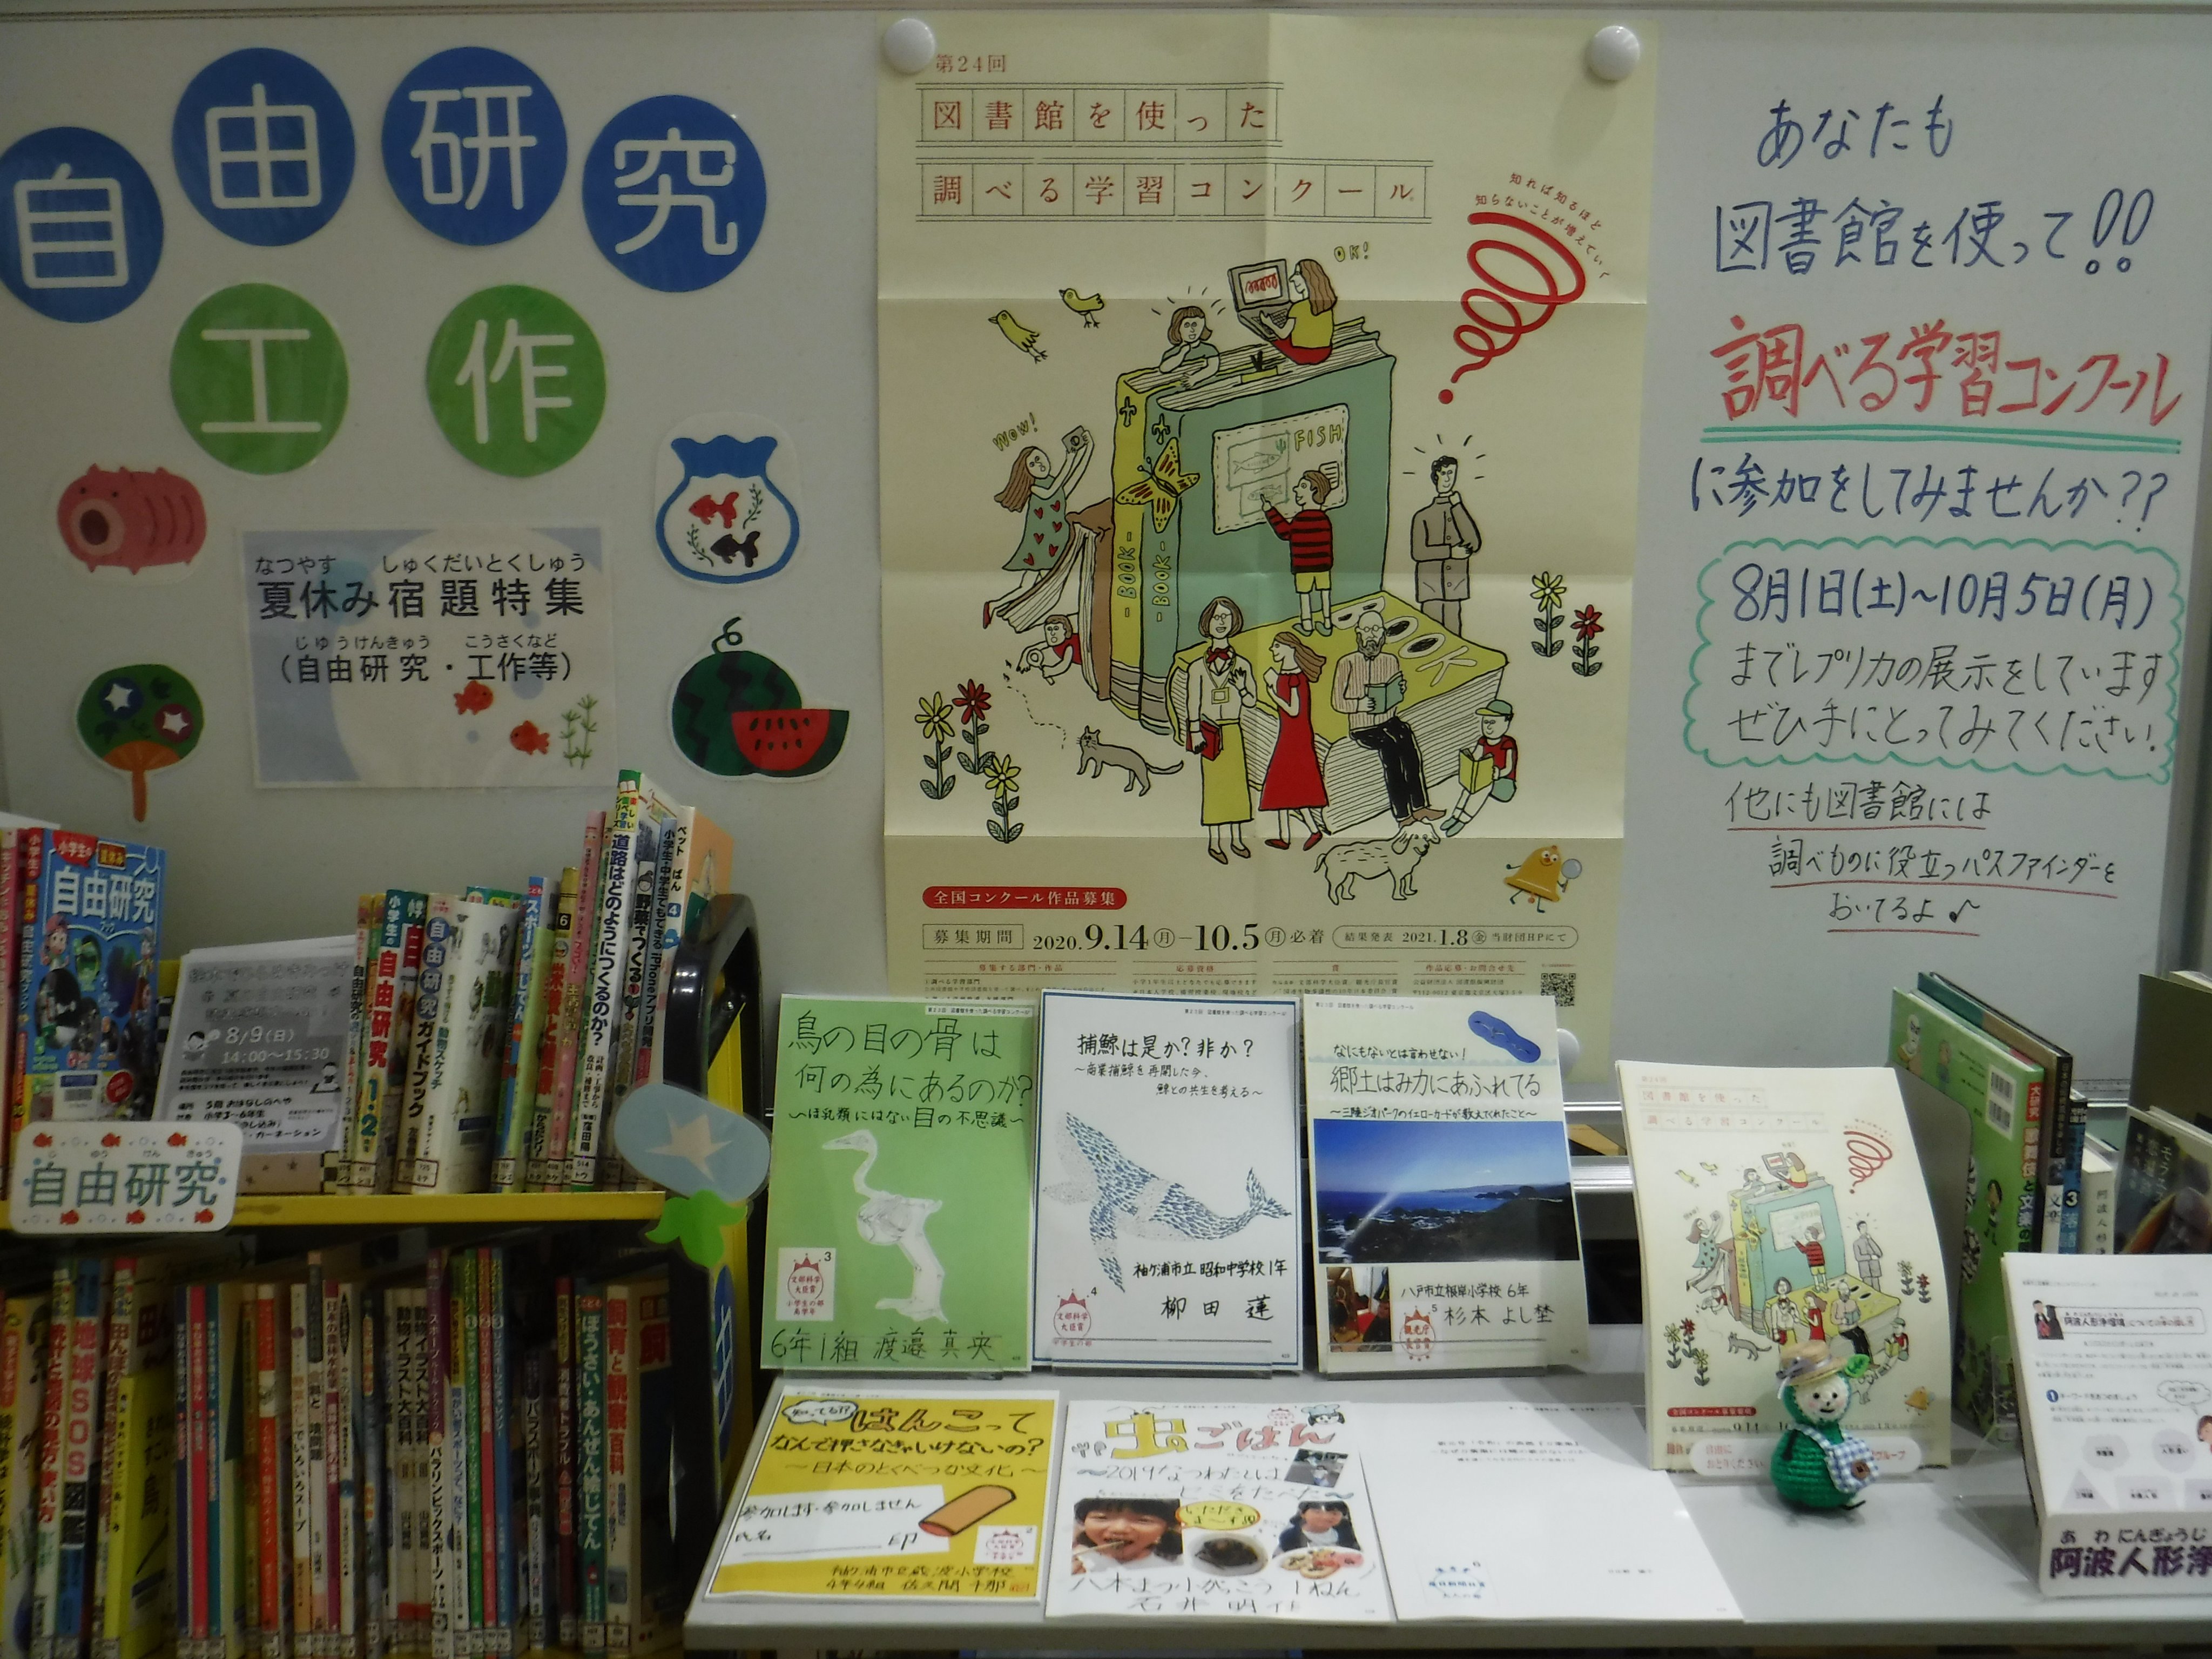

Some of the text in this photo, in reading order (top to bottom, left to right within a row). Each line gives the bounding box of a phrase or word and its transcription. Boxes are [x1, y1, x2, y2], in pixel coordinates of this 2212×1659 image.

[935, 55, 1007, 73] 第24回
[933, 100, 1267, 132] 図書館を使った
[1757, 94, 1952, 168] あなたも
[933, 176, 1411, 205] 調べる学習コンクール
[1509, 173, 1602, 230] 知れば知るほど
[1475, 194, 1609, 279] 知らないことが増えていく
[1334, 241, 1370, 262] OK!
[200, 318, 575, 444] 工作
[1710, 315, 2183, 426] 調べる学習コンクール
[993, 412, 1038, 451] WOW!
[1295, 424, 1344, 453] FISH
[255, 553, 585, 575] なつやす しゅくだいとくしゅう
[257, 577, 584, 620] 夏休み宿題特集
[295, 633, 557, 650] じゆうけんきゅう こうさくなど
[1730, 642, 2163, 705] までレプリカの展示をしています
[1724, 780, 1991, 825] 他にも図書館には
[1769, 834, 2115, 886] 調べものに役立つパスファインダーを
[52, 865, 156, 924] 自由研究
[933, 890, 1116, 906] 全国コンクール作品募集
[1829, 892, 1935, 923] おいてるよ
[934, 929, 1013, 945] 募集期間
[1345, 932, 1394, 942] 結果発表
[368, 950, 398, 1067] 自由研究
[788, 1009, 1002, 1062] 鳥の目の骨は
[1330, 1065, 1541, 1100] 郷土はみ力にあふれてる
[28, 1161, 220, 1209] 自由研究
[2066, 1191, 2078, 1206] 3
[824, 1251, 832, 1262] 3
[791, 1276, 821, 1284] 文部科学
[794, 1285, 817, 1294] 大臣賞
[1091, 1287, 1097, 1296] 4
[1400, 1283, 1502, 1299] 八戸市立根岸小学校
[1057, 1312, 1089, 1320] 文部科学
[1431, 1304, 1438, 1313] 5
[1061, 1323, 1084, 1332] 大臣賞
[771, 1327, 858, 1364] 6年1組
[849, 1406, 1036, 1434] はんこって
